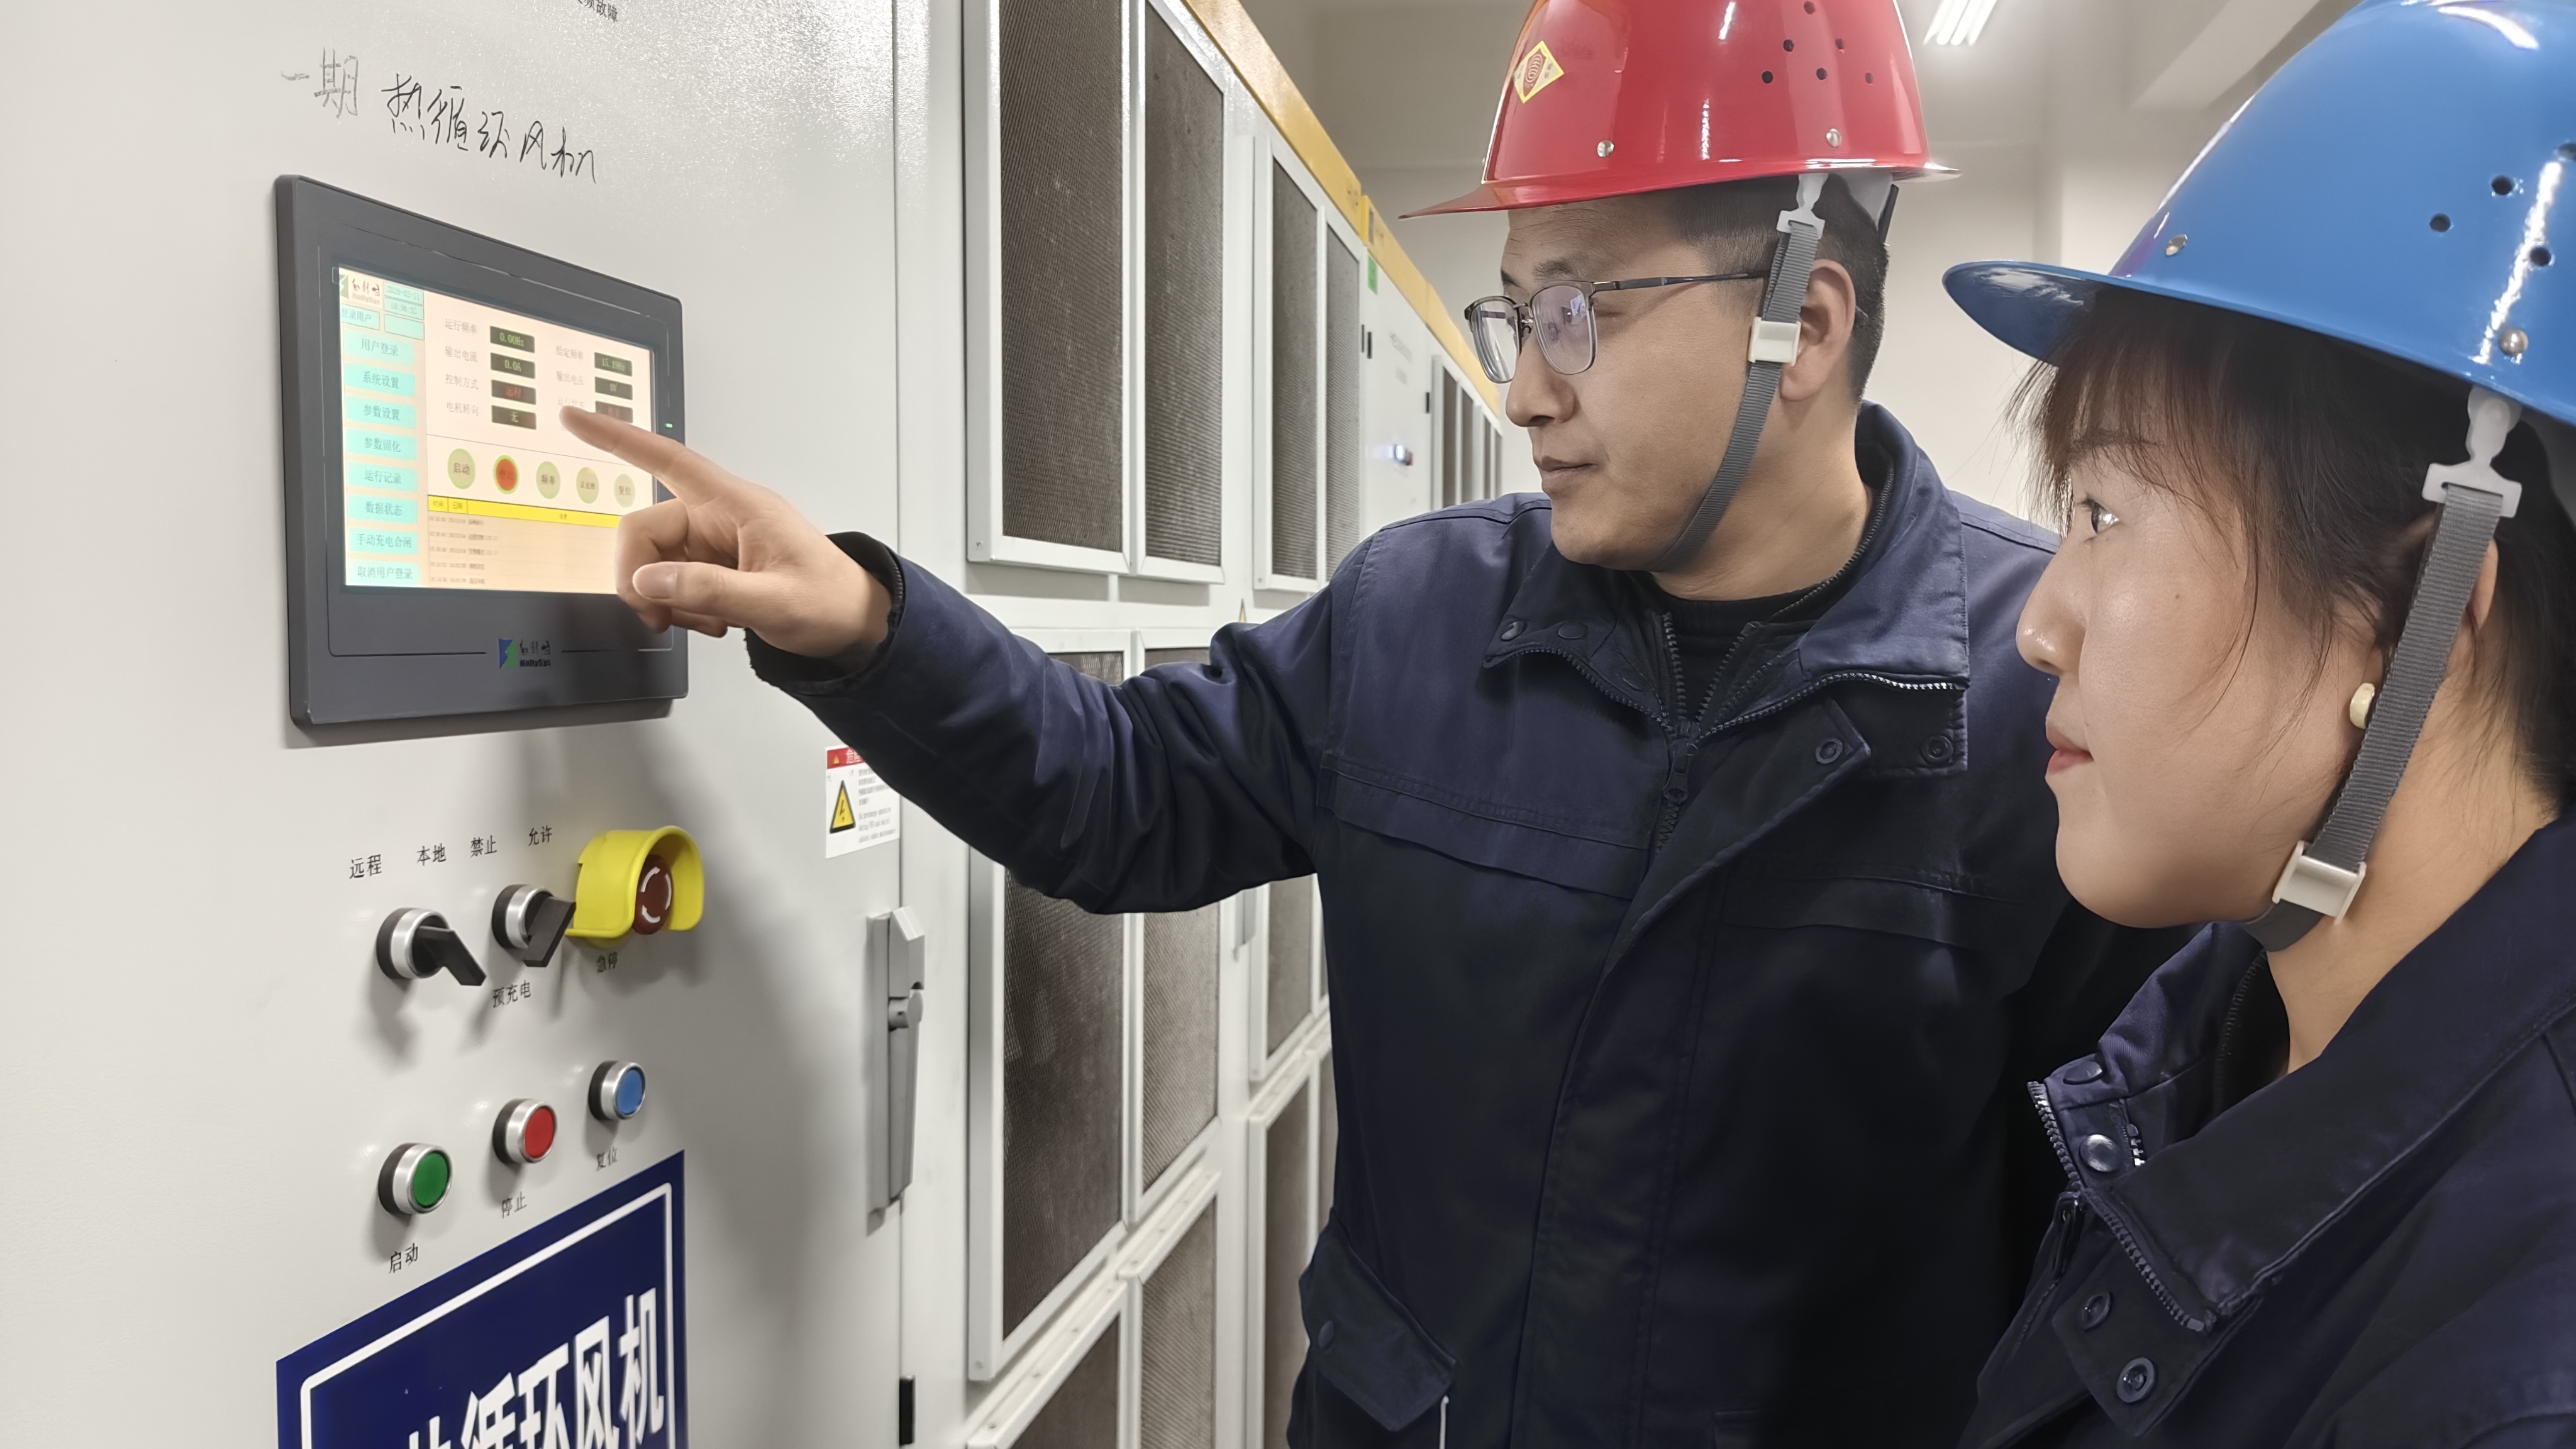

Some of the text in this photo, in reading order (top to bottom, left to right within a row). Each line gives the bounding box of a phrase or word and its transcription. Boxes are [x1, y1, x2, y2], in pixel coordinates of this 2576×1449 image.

[280, 47, 358, 119] 一期
[445, 318, 477, 335] 运行频率
[362, 338, 398, 357] 用户登录
[364, 371, 399, 389] 系统设置
[445, 374, 479, 390] 控制方式
[364, 404, 400, 421] 参数设置
[447, 401, 479, 416] 电机转向
[364, 436, 401, 453] 参数固化
[364, 469, 401, 484] 运行记录
[453, 463, 470, 475] 启动
[365, 501, 402, 516] 数据状态
[357, 533, 412, 548] 手动充电合闸
[357, 566, 413, 580] 取消用户登录
[528, 824, 552, 847] 允许
[417, 843, 447, 866] 本地
[470, 835, 497, 858] 禁止
[350, 854, 382, 879] 远程
[492, 980, 531, 1008] 预充电
[596, 1147, 618, 1171] 复位
[502, 1191, 528, 1218] 停止
[389, 1243, 418, 1274] 启动
